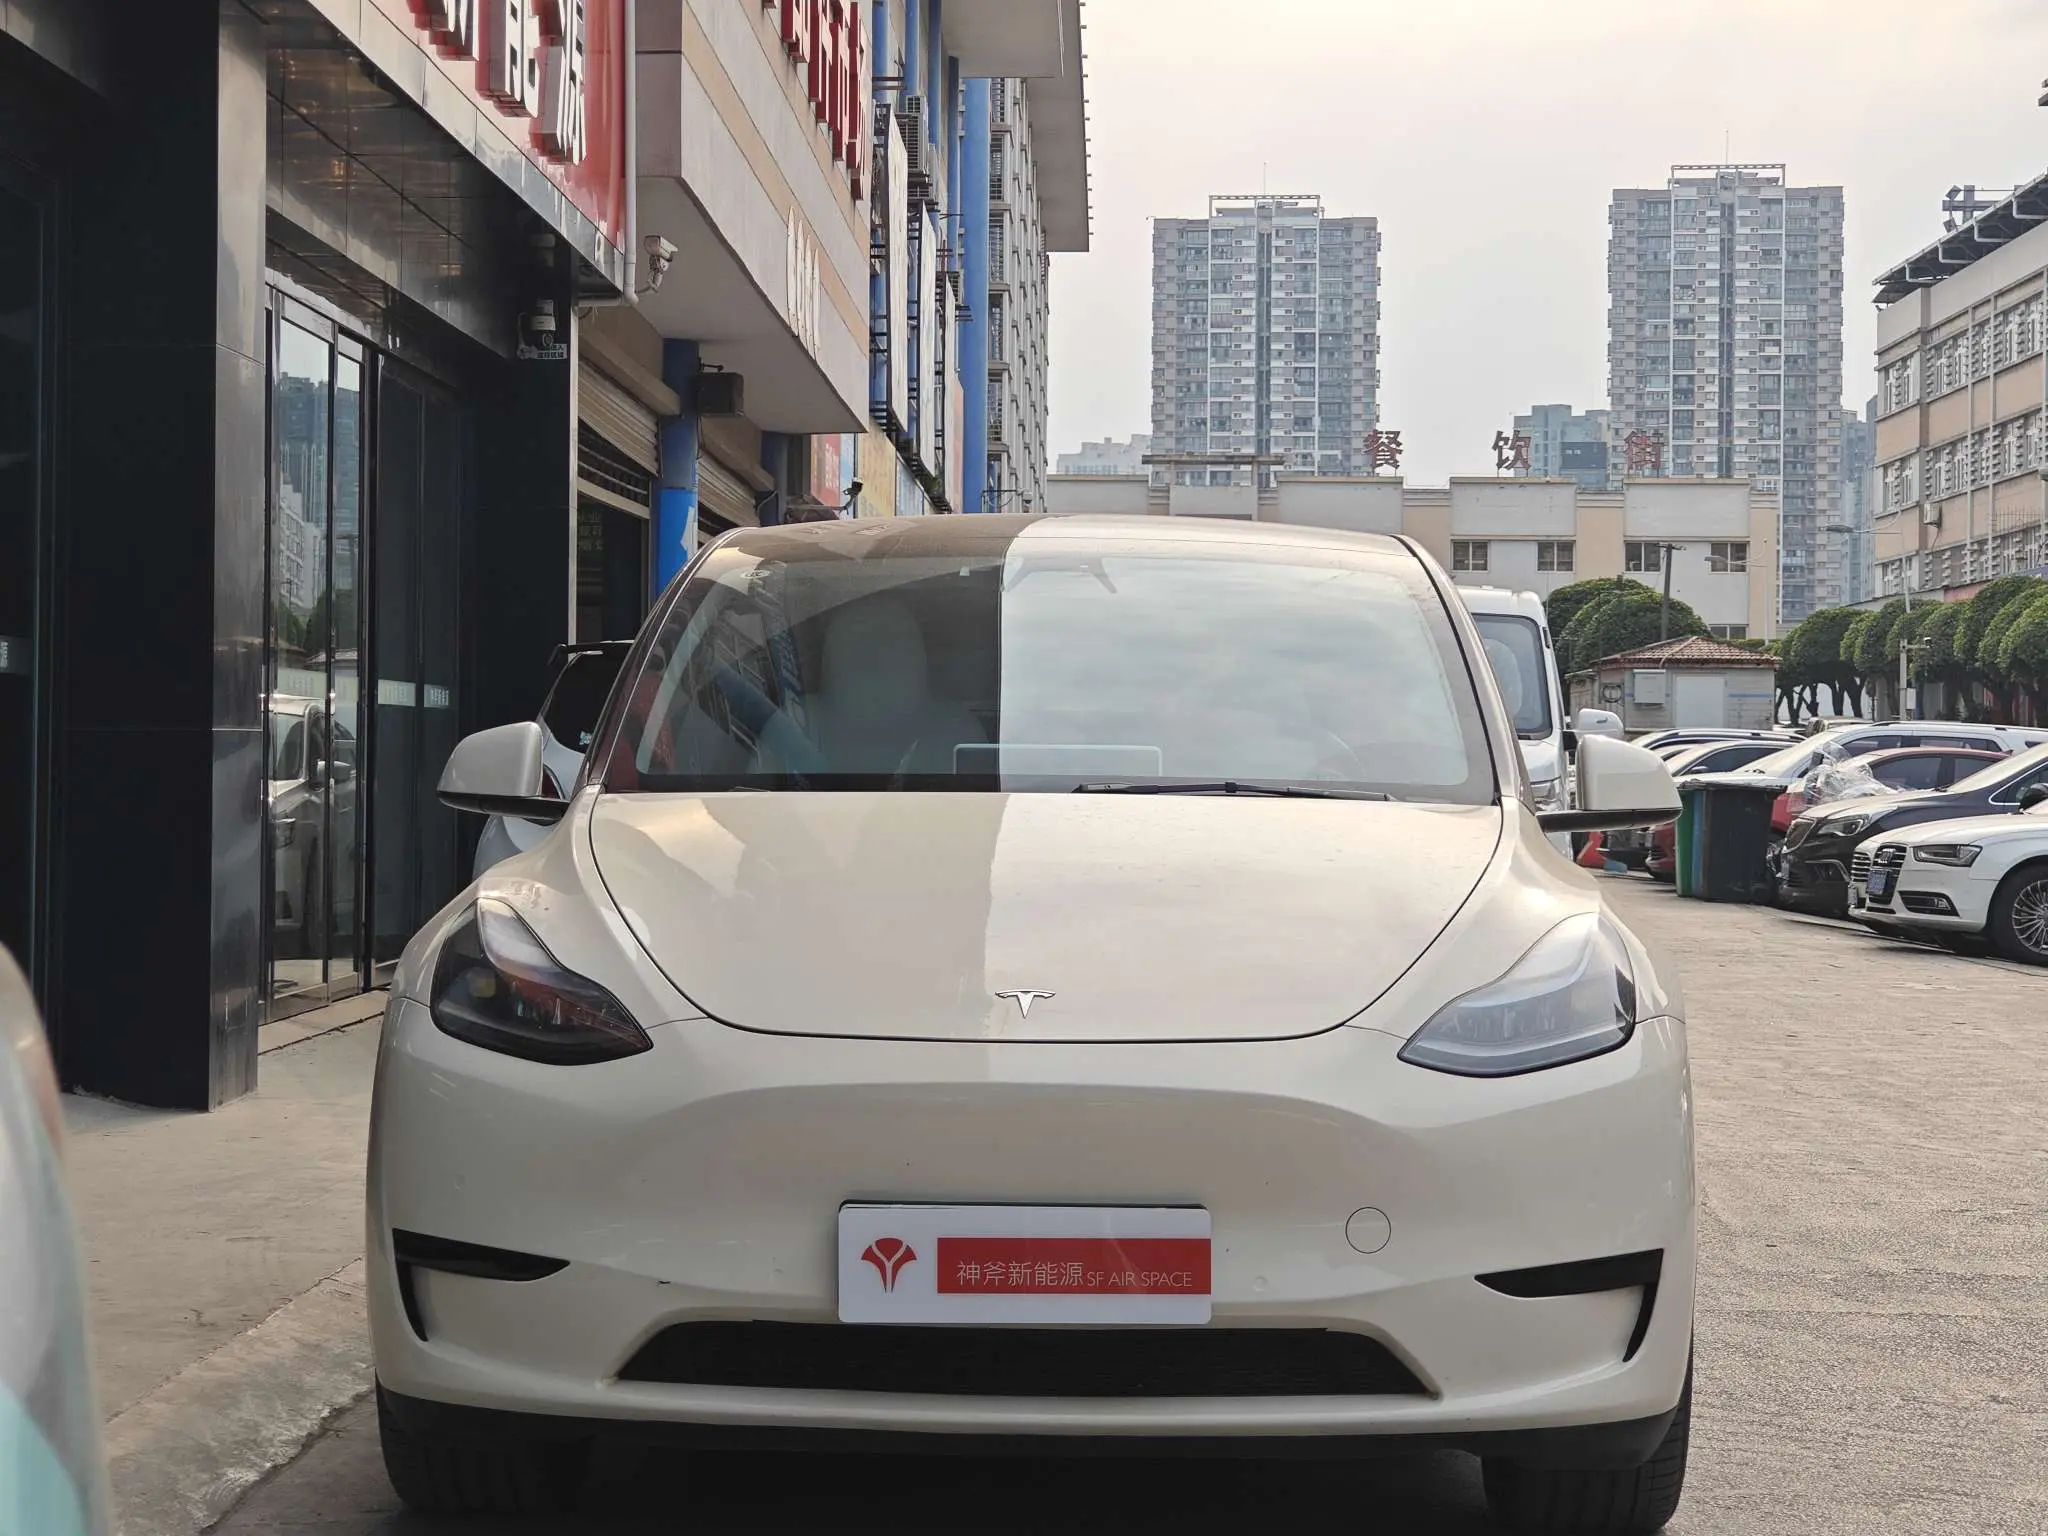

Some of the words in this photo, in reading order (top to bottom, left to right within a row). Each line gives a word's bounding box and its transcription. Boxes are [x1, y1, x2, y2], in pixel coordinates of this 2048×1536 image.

[956, 1260, 1084, 1287] 神斧新能源
[1086, 1271, 1105, 1287] SF
[1108, 1271, 1136, 1287] AIR
[1140, 1271, 1193, 1287] SPACE
